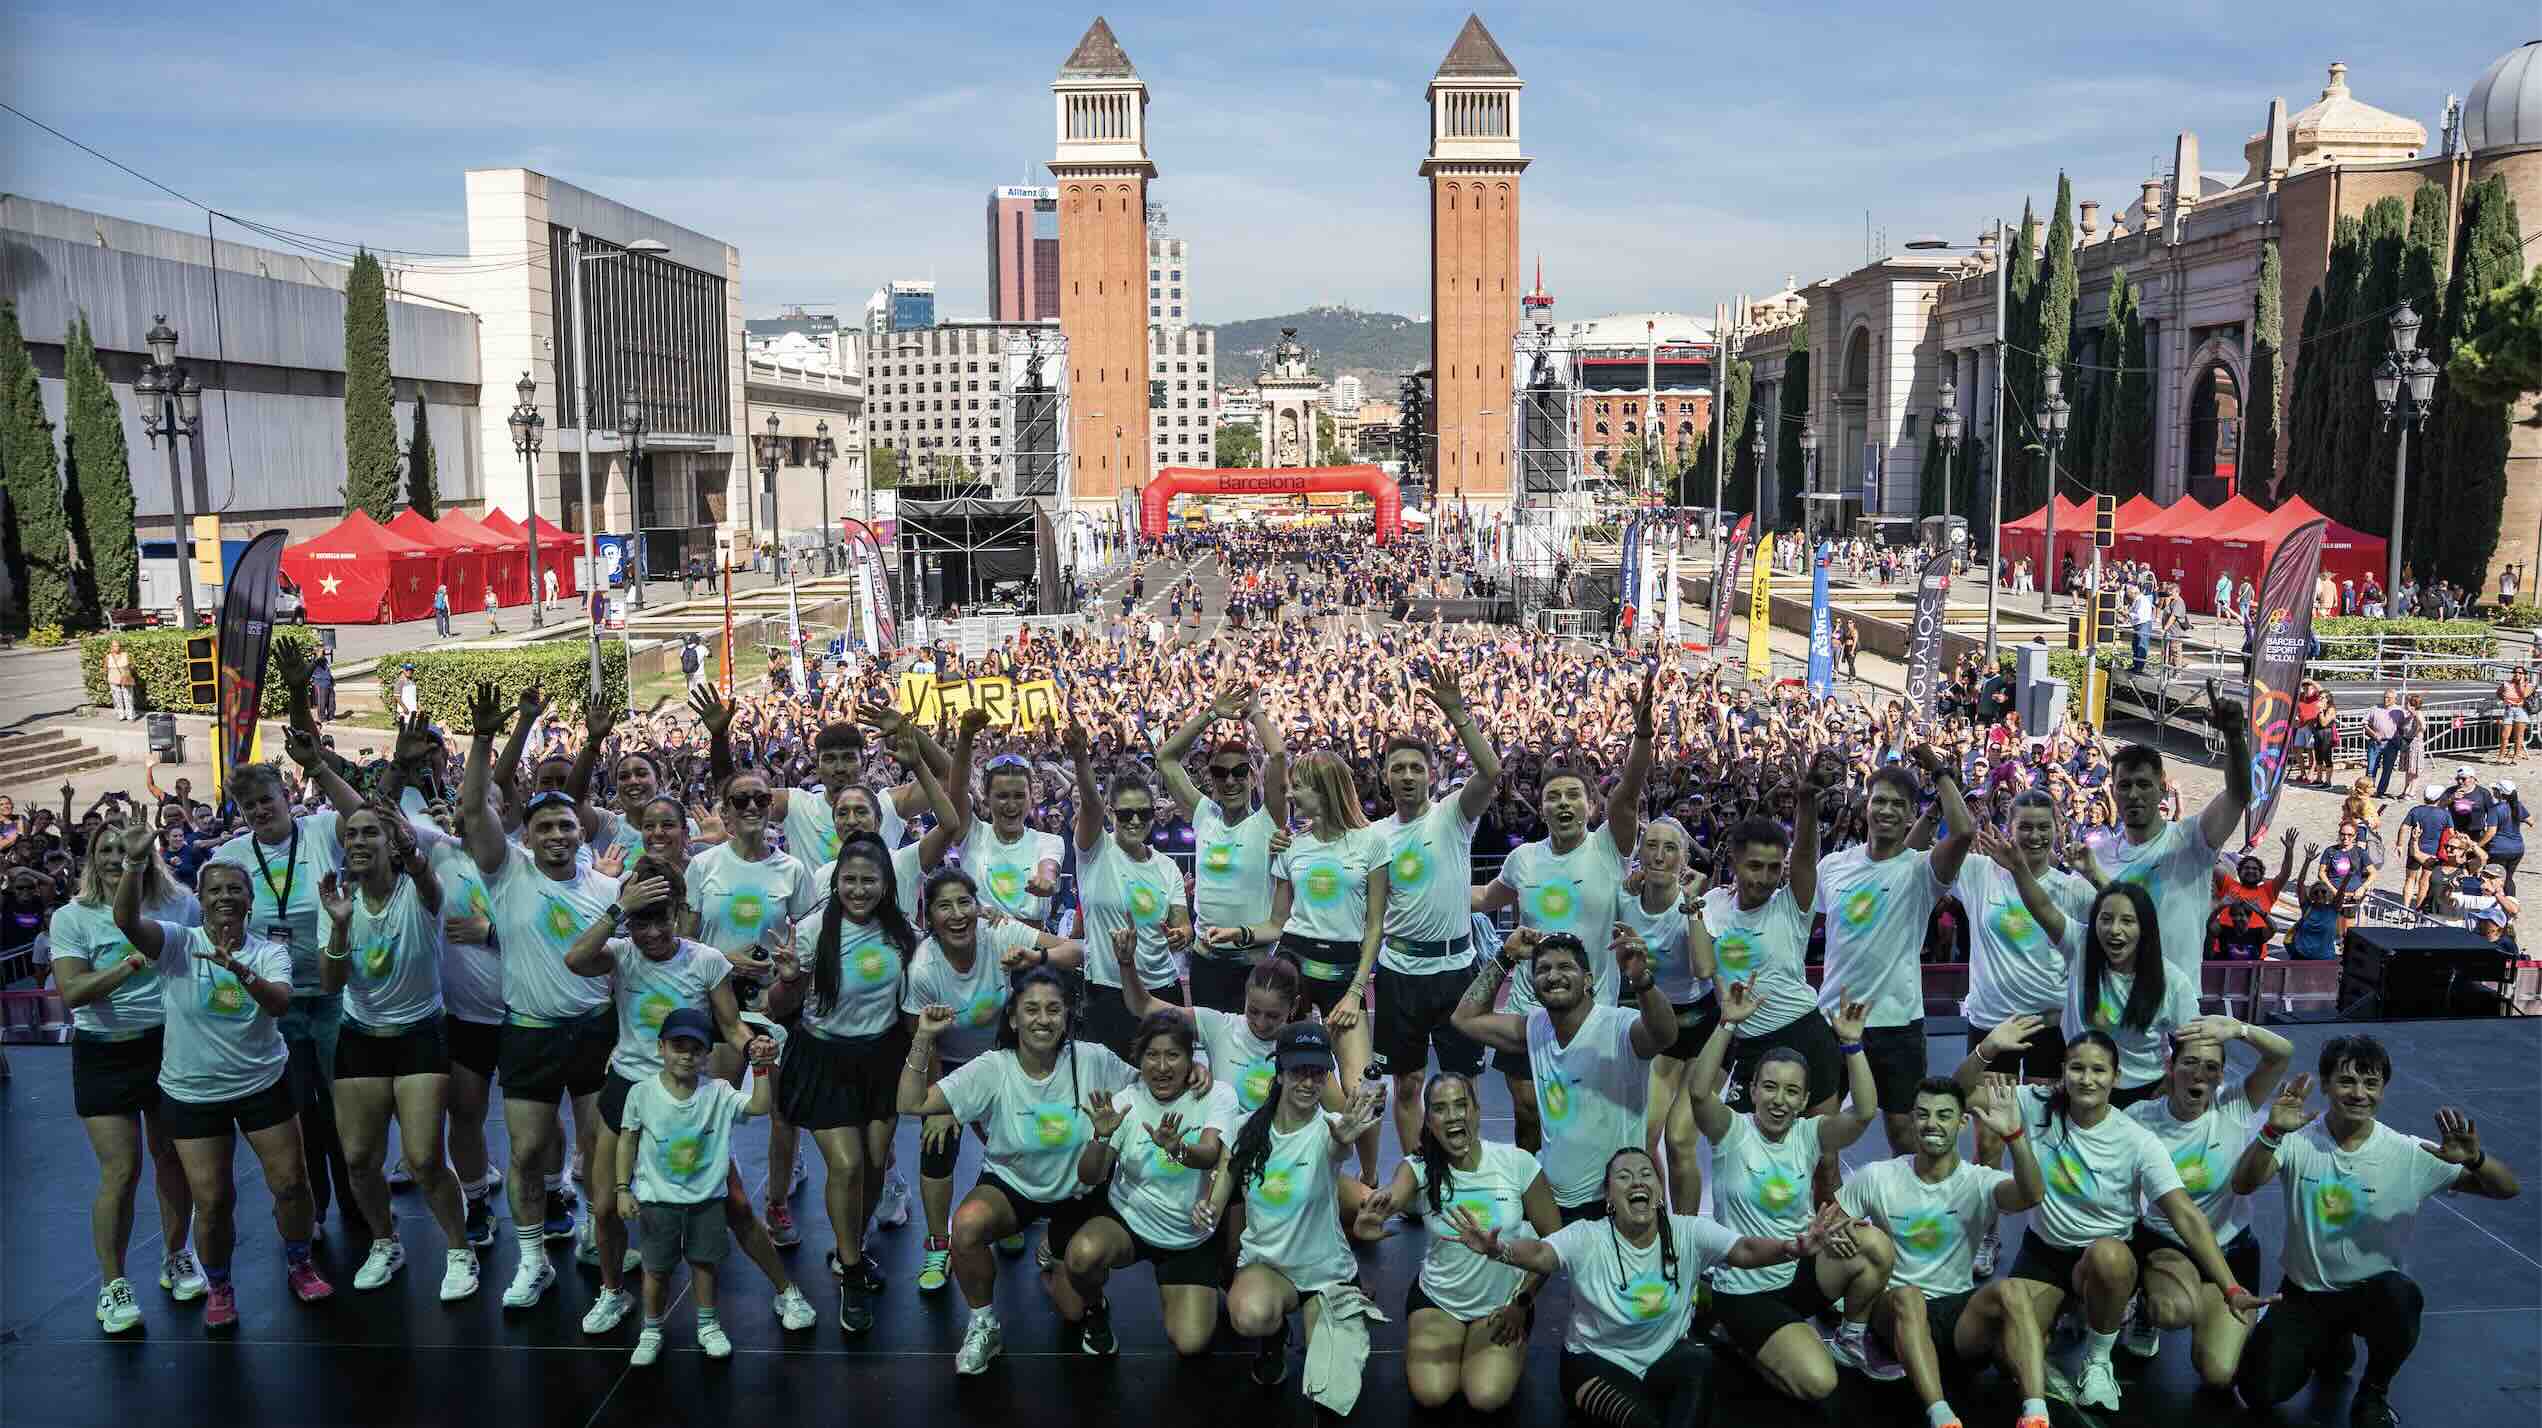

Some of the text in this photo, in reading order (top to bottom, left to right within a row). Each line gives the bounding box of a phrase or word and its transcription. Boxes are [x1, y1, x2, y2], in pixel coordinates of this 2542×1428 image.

[1007, 188, 1037, 197] Allianz
[1219, 474, 1305, 489] Barcelona
[2266, 646, 2298, 655] ESPORT
